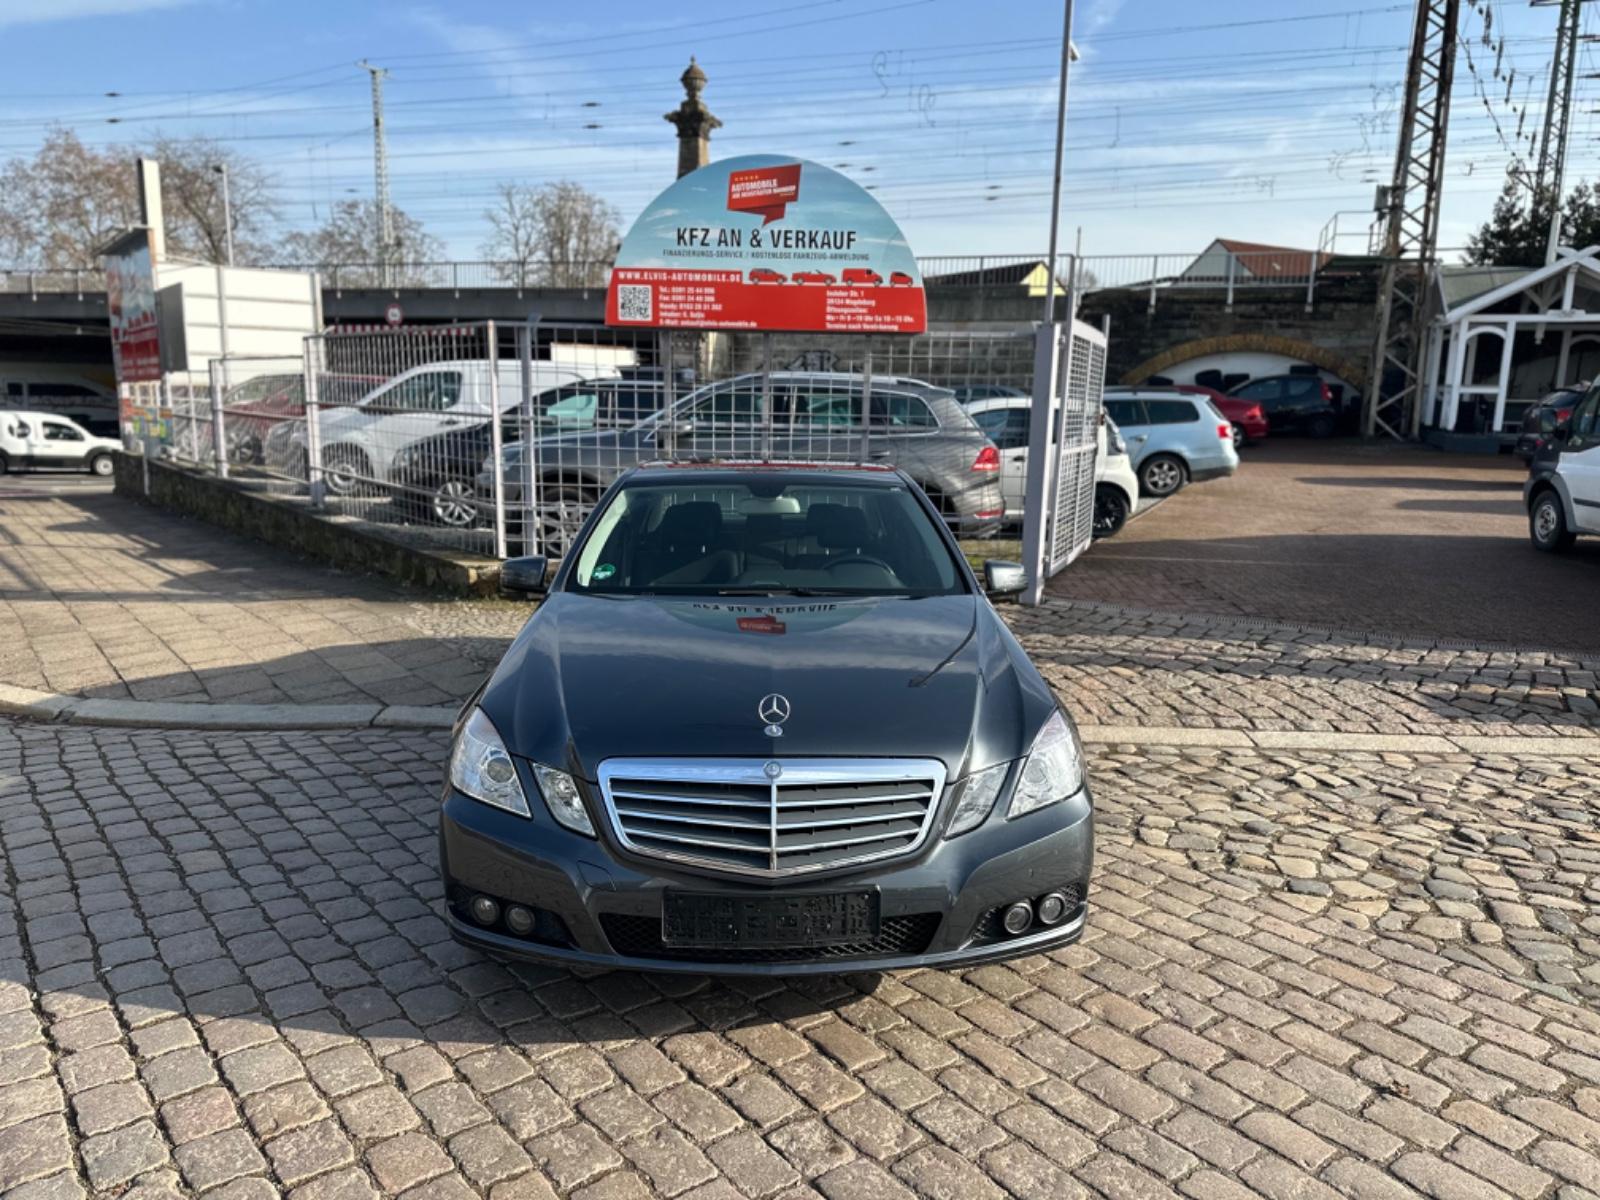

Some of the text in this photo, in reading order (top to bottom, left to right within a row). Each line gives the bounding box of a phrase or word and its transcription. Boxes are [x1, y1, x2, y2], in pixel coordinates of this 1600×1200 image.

[732, 179, 777, 192] AUTOMOBILE
[677, 228, 857, 250] KFZ AN & VERKAUF
[663, 249, 743, 258] FINANZIERUNGS-SERVICE
[751, 250, 792, 259] KOSTENLOSE
[793, 251, 869, 261] FAHRZEUG-ABMELDUNG
[618, 271, 741, 282] WWW.ELVIS-AUTOMOBILE.DE
[845, 299, 876, 307] Magdeburg
